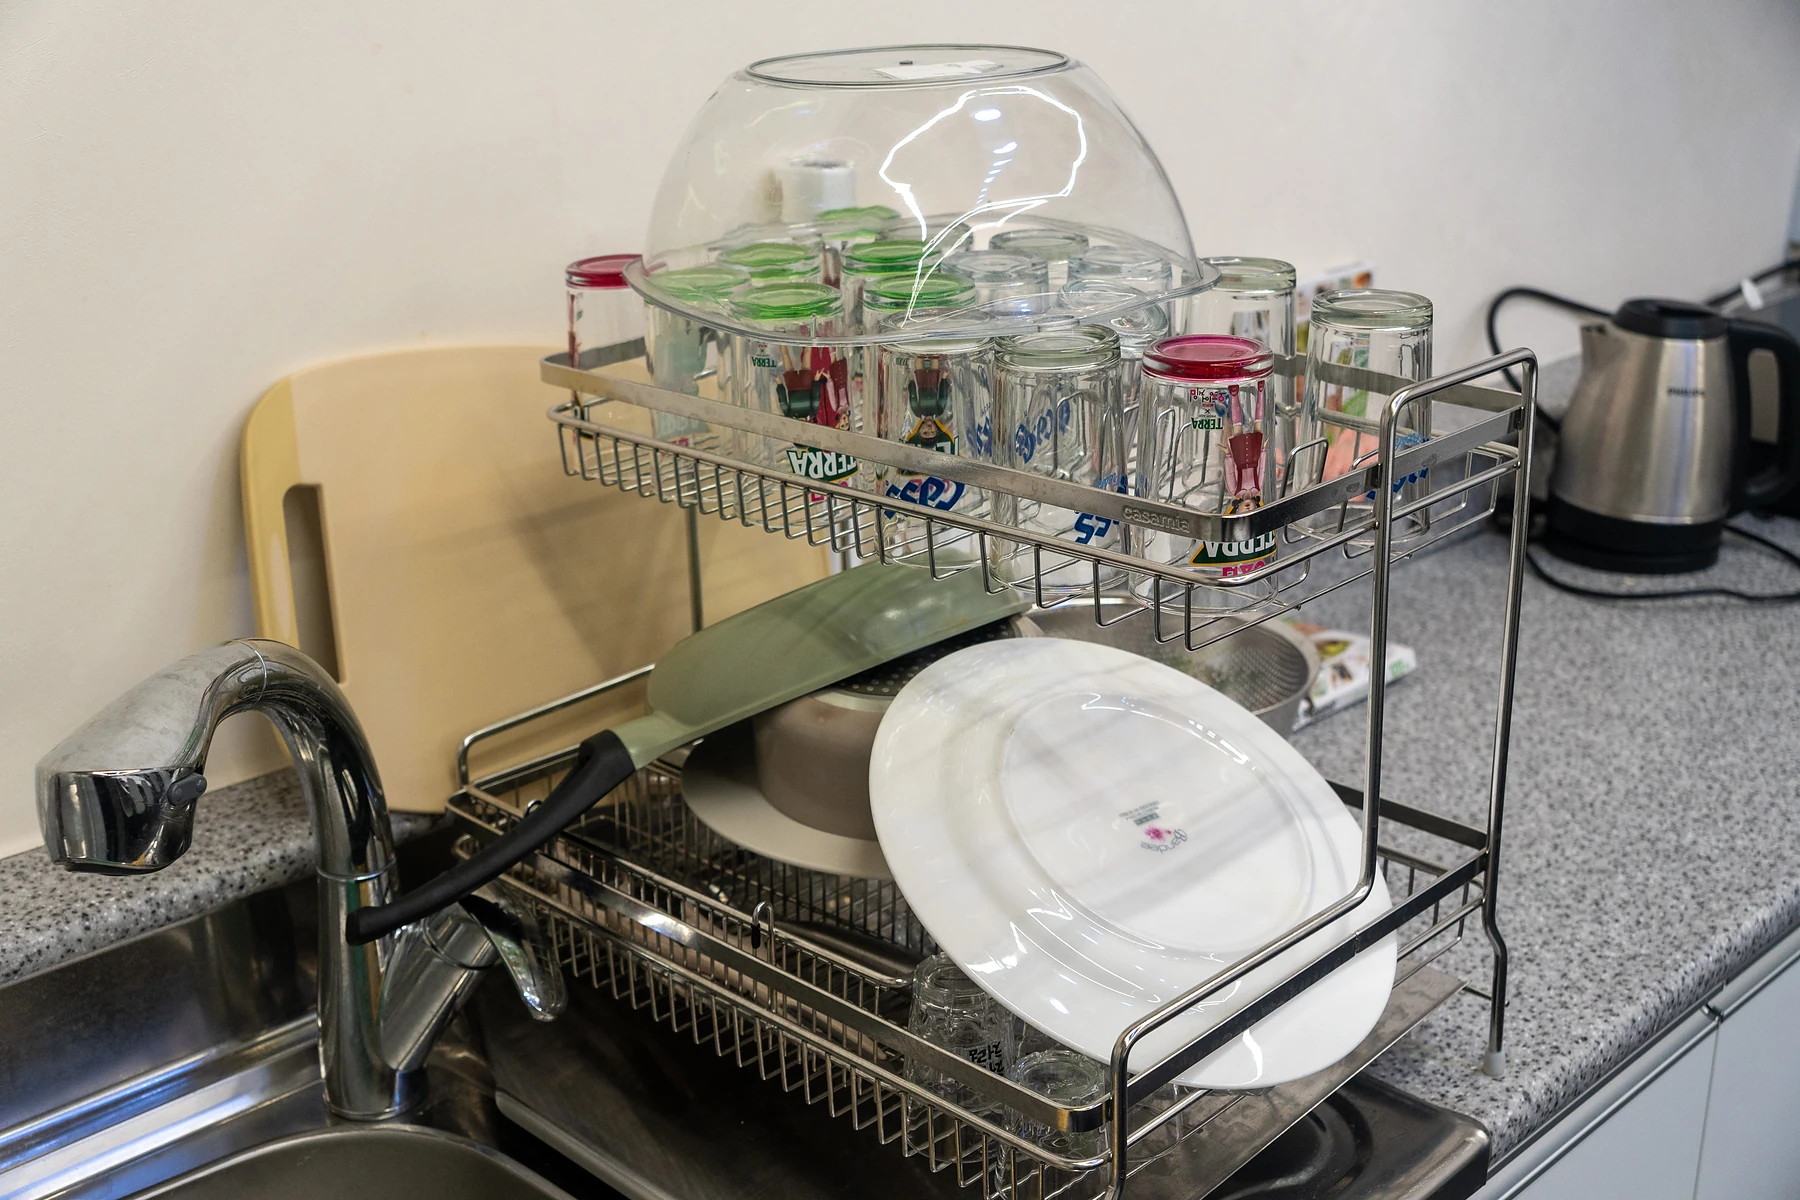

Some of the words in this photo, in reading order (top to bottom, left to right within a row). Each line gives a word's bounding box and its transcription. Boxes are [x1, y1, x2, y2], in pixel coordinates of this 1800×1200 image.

[751, 356, 777, 368] TERRA
[1191, 417, 1223, 430] TERRA
[788, 450, 857, 480] TERRA
[1123, 506, 1191, 533] casamia
